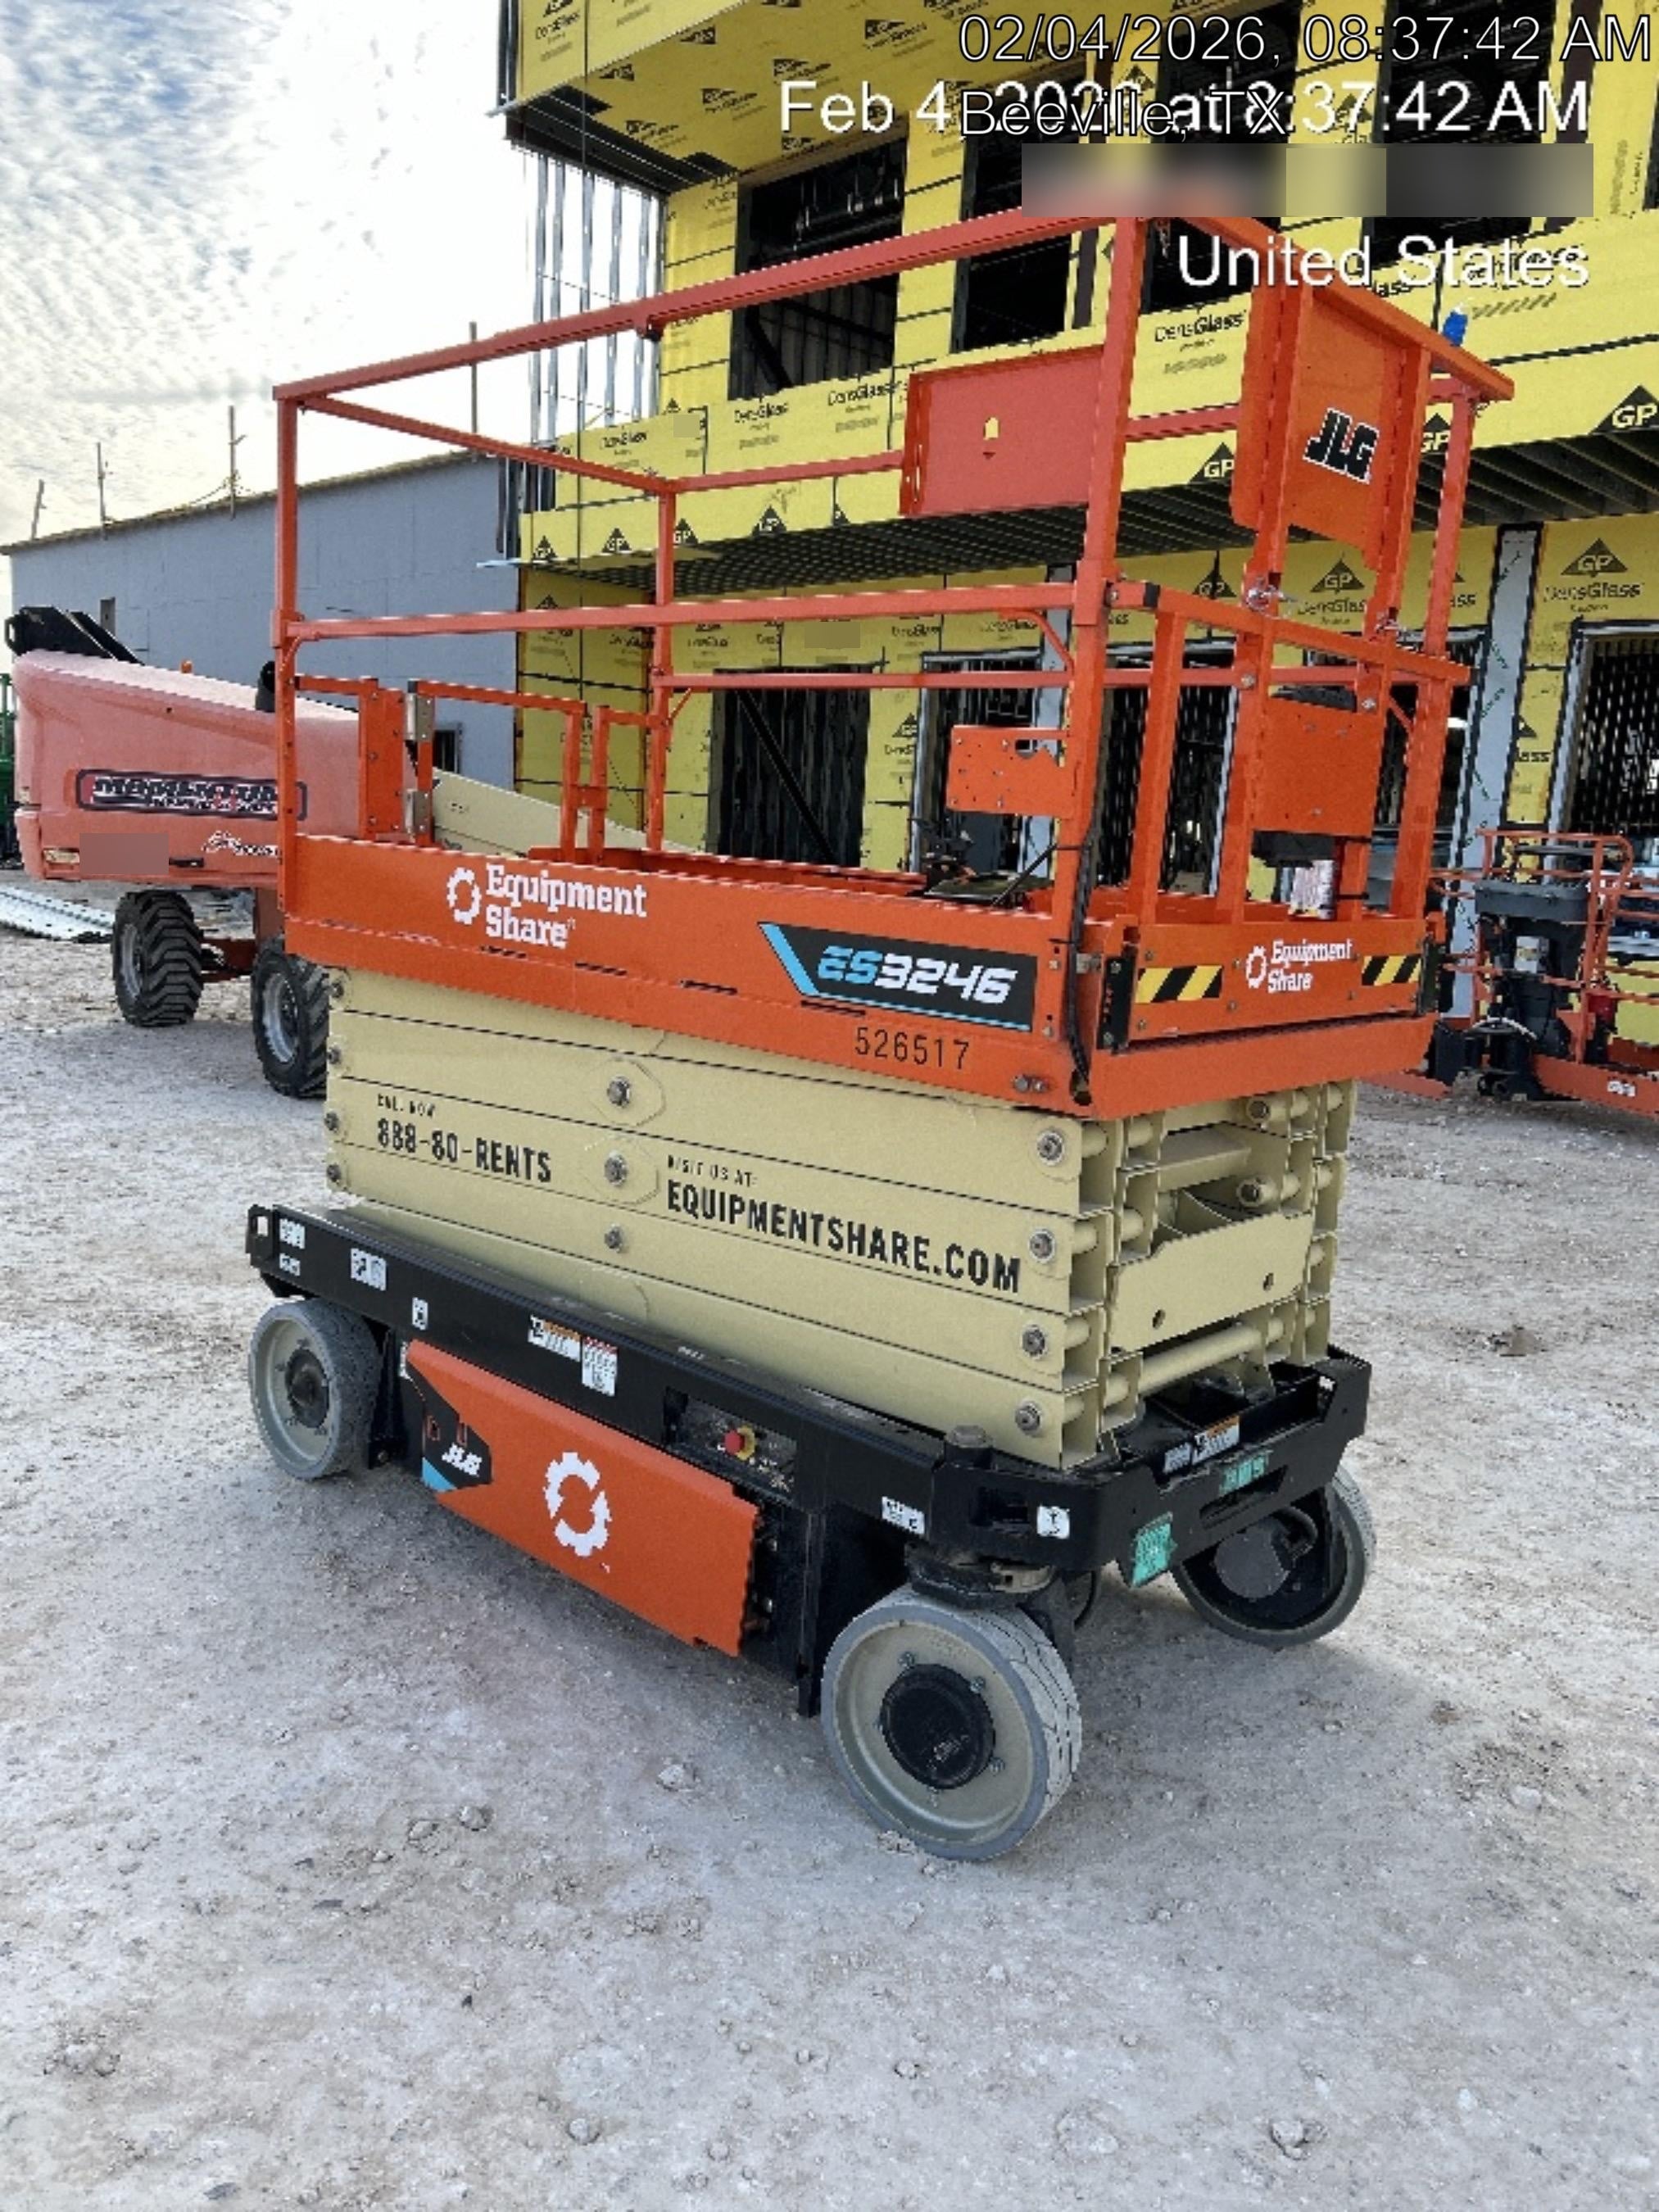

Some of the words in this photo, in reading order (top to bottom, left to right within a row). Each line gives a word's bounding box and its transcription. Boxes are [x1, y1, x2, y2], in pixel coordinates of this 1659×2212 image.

[1611, 402, 1657, 428] GP
[1303, 408, 1380, 484] JLG
[1324, 573, 1353, 588] GP
[1578, 555, 1614, 572] GP
[485, 862, 647, 918] Equipment
[486, 904, 569, 950] Share
[818, 945, 1018, 1005] ES3246
[1271, 938, 1353, 968] Equipment
[1267, 968, 1314, 994] Share
[855, 1026, 970, 1070] 526517
[378, 1117, 551, 1184] 888-80-RENTS
[667, 1179, 1022, 1294] EQUIPMENTSHARE.COM
